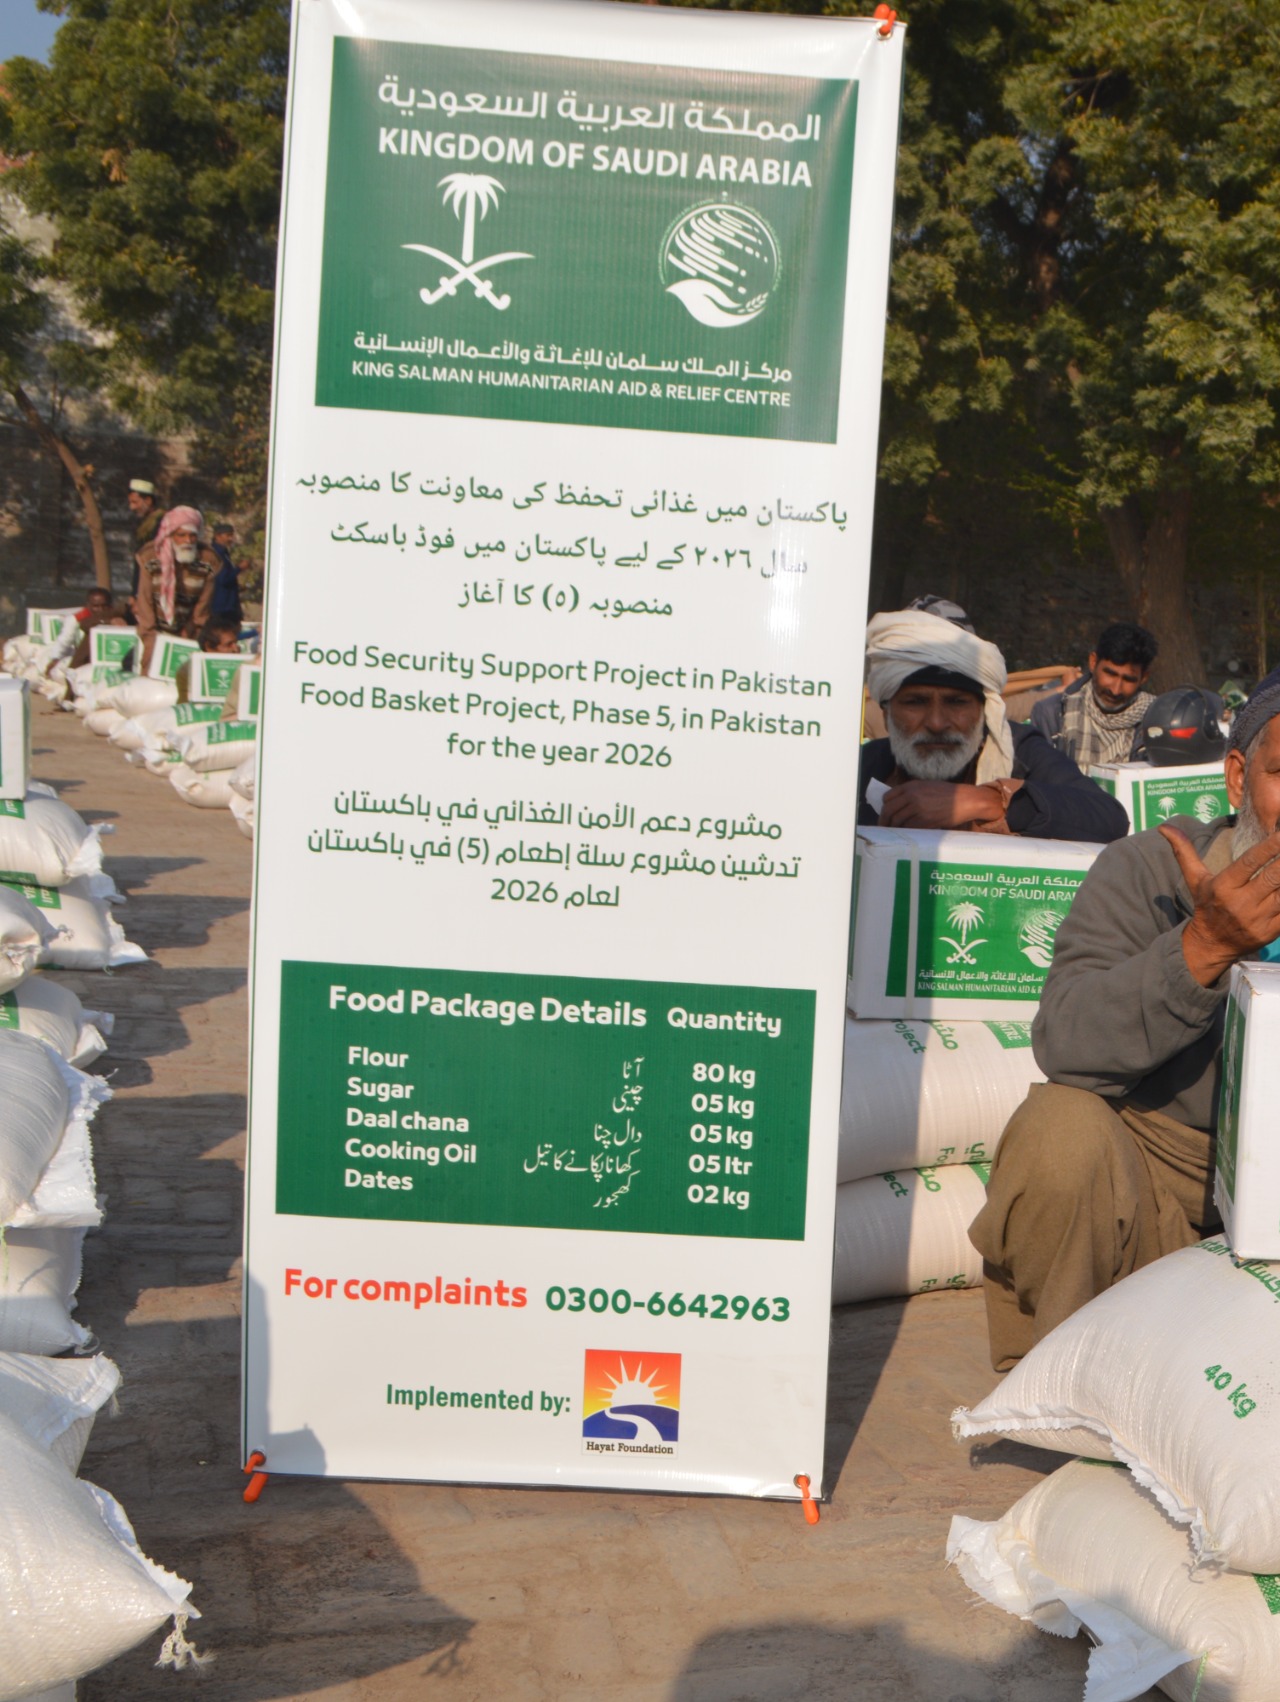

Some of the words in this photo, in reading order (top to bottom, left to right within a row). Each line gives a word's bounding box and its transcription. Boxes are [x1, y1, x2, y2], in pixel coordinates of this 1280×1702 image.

[378, 74, 549, 119] السعودية
[556, 89, 678, 133] العربية
[683, 99, 821, 143] المملكة
[378, 127, 534, 166] KINGDOM
[542, 140, 586, 169] OF
[592, 144, 689, 178] SAUDI
[695, 153, 813, 188] ARABIA
[605, 351, 680, 373] سلمان
[681, 356, 740, 378] الملك
[740, 360, 793, 384] مركز
[351, 360, 395, 379] KING
[397, 363, 474, 384] SALMAN
[477, 369, 615, 395] HUMANITARIAN
[616, 379, 648, 397] AID
[649, 382, 663, 398] &
[665, 383, 722, 402] RELIEF
[723, 387, 793, 409] CENTRE
[419, 477, 504, 506] معاونت
[555, 483, 623, 510] تحفظ
[293, 640, 358, 668] Food
[364, 645, 475, 681] Security
[480, 652, 588, 685] Support
[593, 660, 688, 692] Project
[692, 668, 715, 690] in
[721, 668, 832, 699] Pakistan
[300, 681, 365, 709] Food
[370, 687, 460, 715] Basket
[465, 692, 565, 725] Project,
[573, 699, 652, 728] Phase
[656, 705, 678, 734] 5,
[681, 712, 705, 730] in
[710, 708, 822, 738] Pakistan
[447, 732, 486, 757] for
[491, 735, 536, 761] the
[542, 745, 599, 768] year
[605, 742, 673, 769] 2026
[334, 791, 433, 822] باكستان
[436, 802, 479, 828] في
[483, 799, 573, 831] الغذائي
[577, 803, 636, 831] الأمن
[639, 815, 692, 836] دعم
[695, 815, 782, 843] مشروع
[307, 829, 405, 863] باكستان
[409, 835, 451, 865] في
[457, 837, 491, 865] (5)
[495, 840, 571, 871] إطعام
[576, 843, 626, 868] سلة
[630, 849, 716, 877] مشروع
[720, 853, 801, 881] تدشين
[490, 877, 559, 905] 2026
[563, 884, 621, 911] لعام
[990, 887, 1007, 899] OF
[1009, 889, 1045, 900] SAUDI
[329, 984, 405, 1014] Food
[410, 989, 536, 1026] Package
[540, 996, 647, 1027] Details
[666, 1006, 782, 1039] Quantity
[348, 1045, 410, 1068] Flour
[346, 1076, 415, 1103] Sugar
[691, 1062, 725, 1083] 80
[728, 1064, 756, 1090] kg
[346, 1107, 398, 1129] Daal
[401, 1110, 470, 1133] chana
[691, 1092, 724, 1114] 05
[727, 1094, 755, 1120] kg
[689, 1123, 723, 1144] 05
[725, 1125, 754, 1150] kg
[344, 1137, 441, 1167] Cooking
[443, 1142, 477, 1164] Oil
[688, 1153, 721, 1174] 05
[724, 1155, 753, 1176] ltr
[344, 1168, 414, 1191] Dates
[687, 1183, 720, 1204] 02
[722, 1185, 750, 1211] kg
[284, 1268, 339, 1300] For
[343, 1275, 528, 1311] complaints
[546, 1286, 790, 1322] 0300-6642963
[386, 1384, 533, 1411] Implemented
[540, 1391, 570, 1417] by:
[1203, 1363, 1233, 1391] 40
[1227, 1386, 1257, 1419] kg
[586, 1441, 615, 1454] Hayat
[617, 1442, 674, 1455] Foundation
